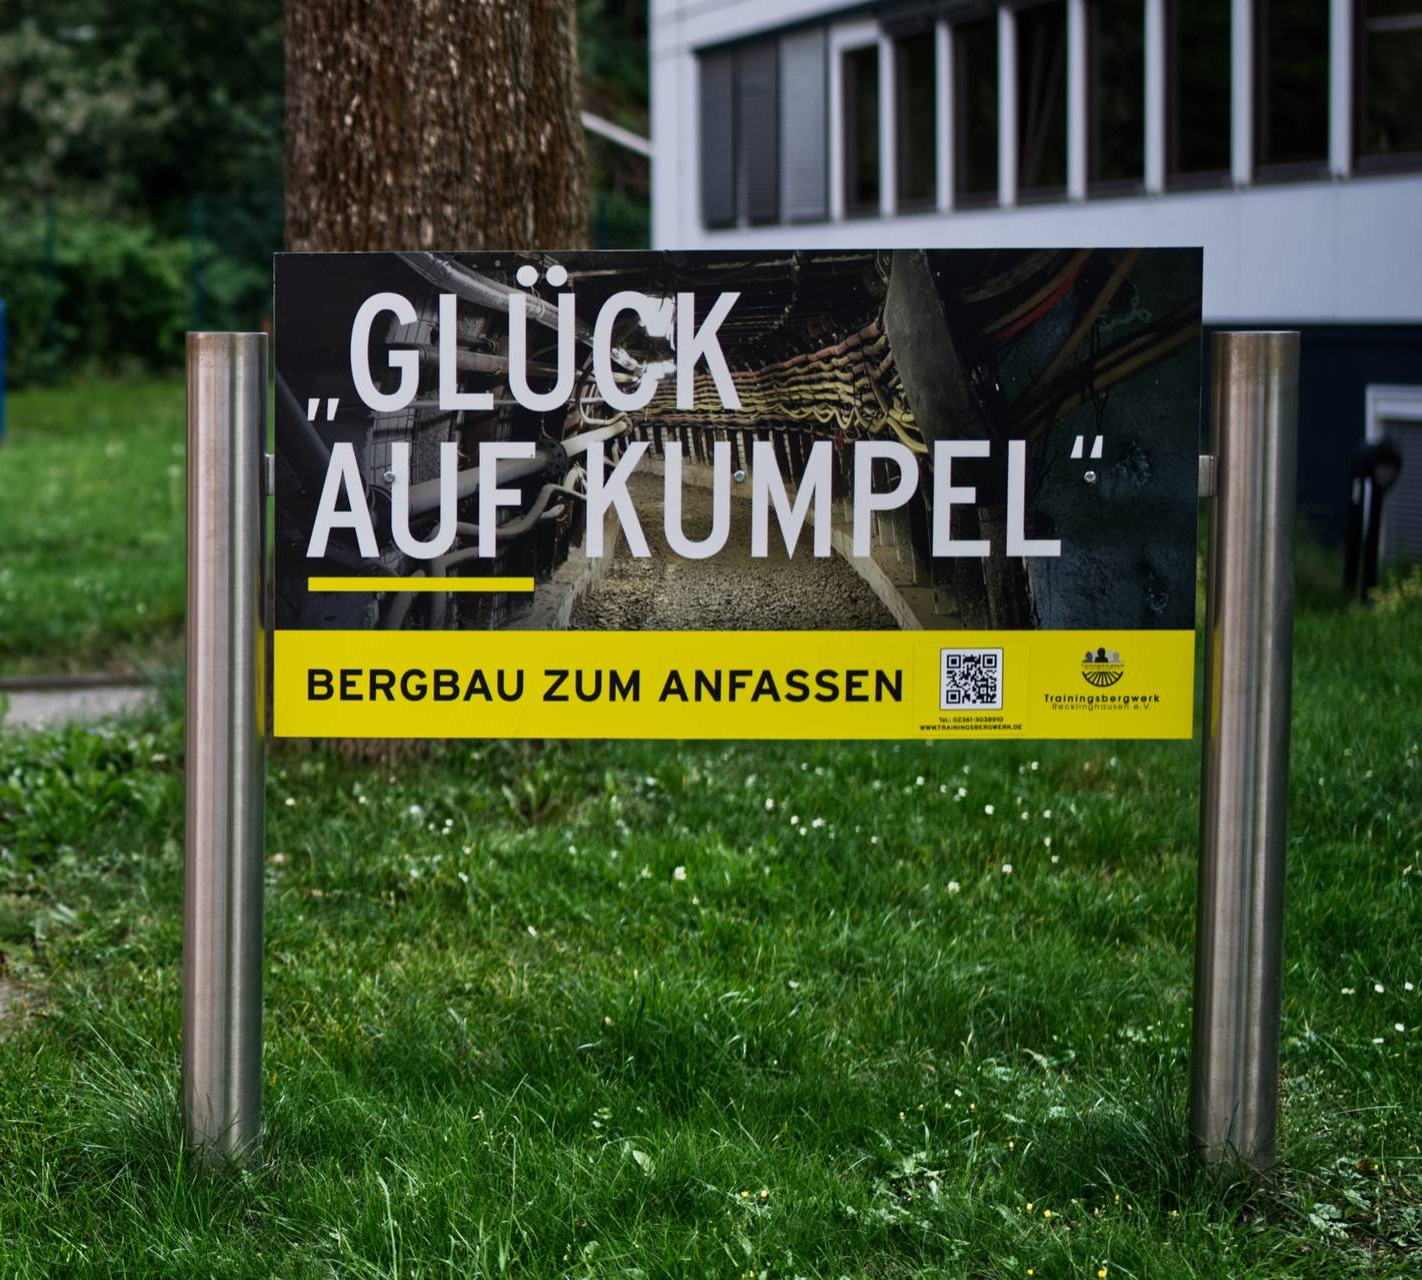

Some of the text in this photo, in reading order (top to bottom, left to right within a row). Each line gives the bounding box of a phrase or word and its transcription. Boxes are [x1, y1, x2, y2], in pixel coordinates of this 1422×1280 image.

[306, 440, 537, 560] AUF
[307, 668, 904, 703] BERGBAU ZUM ANFASSEN
[1043, 693, 1160, 705] Trainingsbergwerk
[1051, 702, 1152, 712] Recklinghausen e.V.
